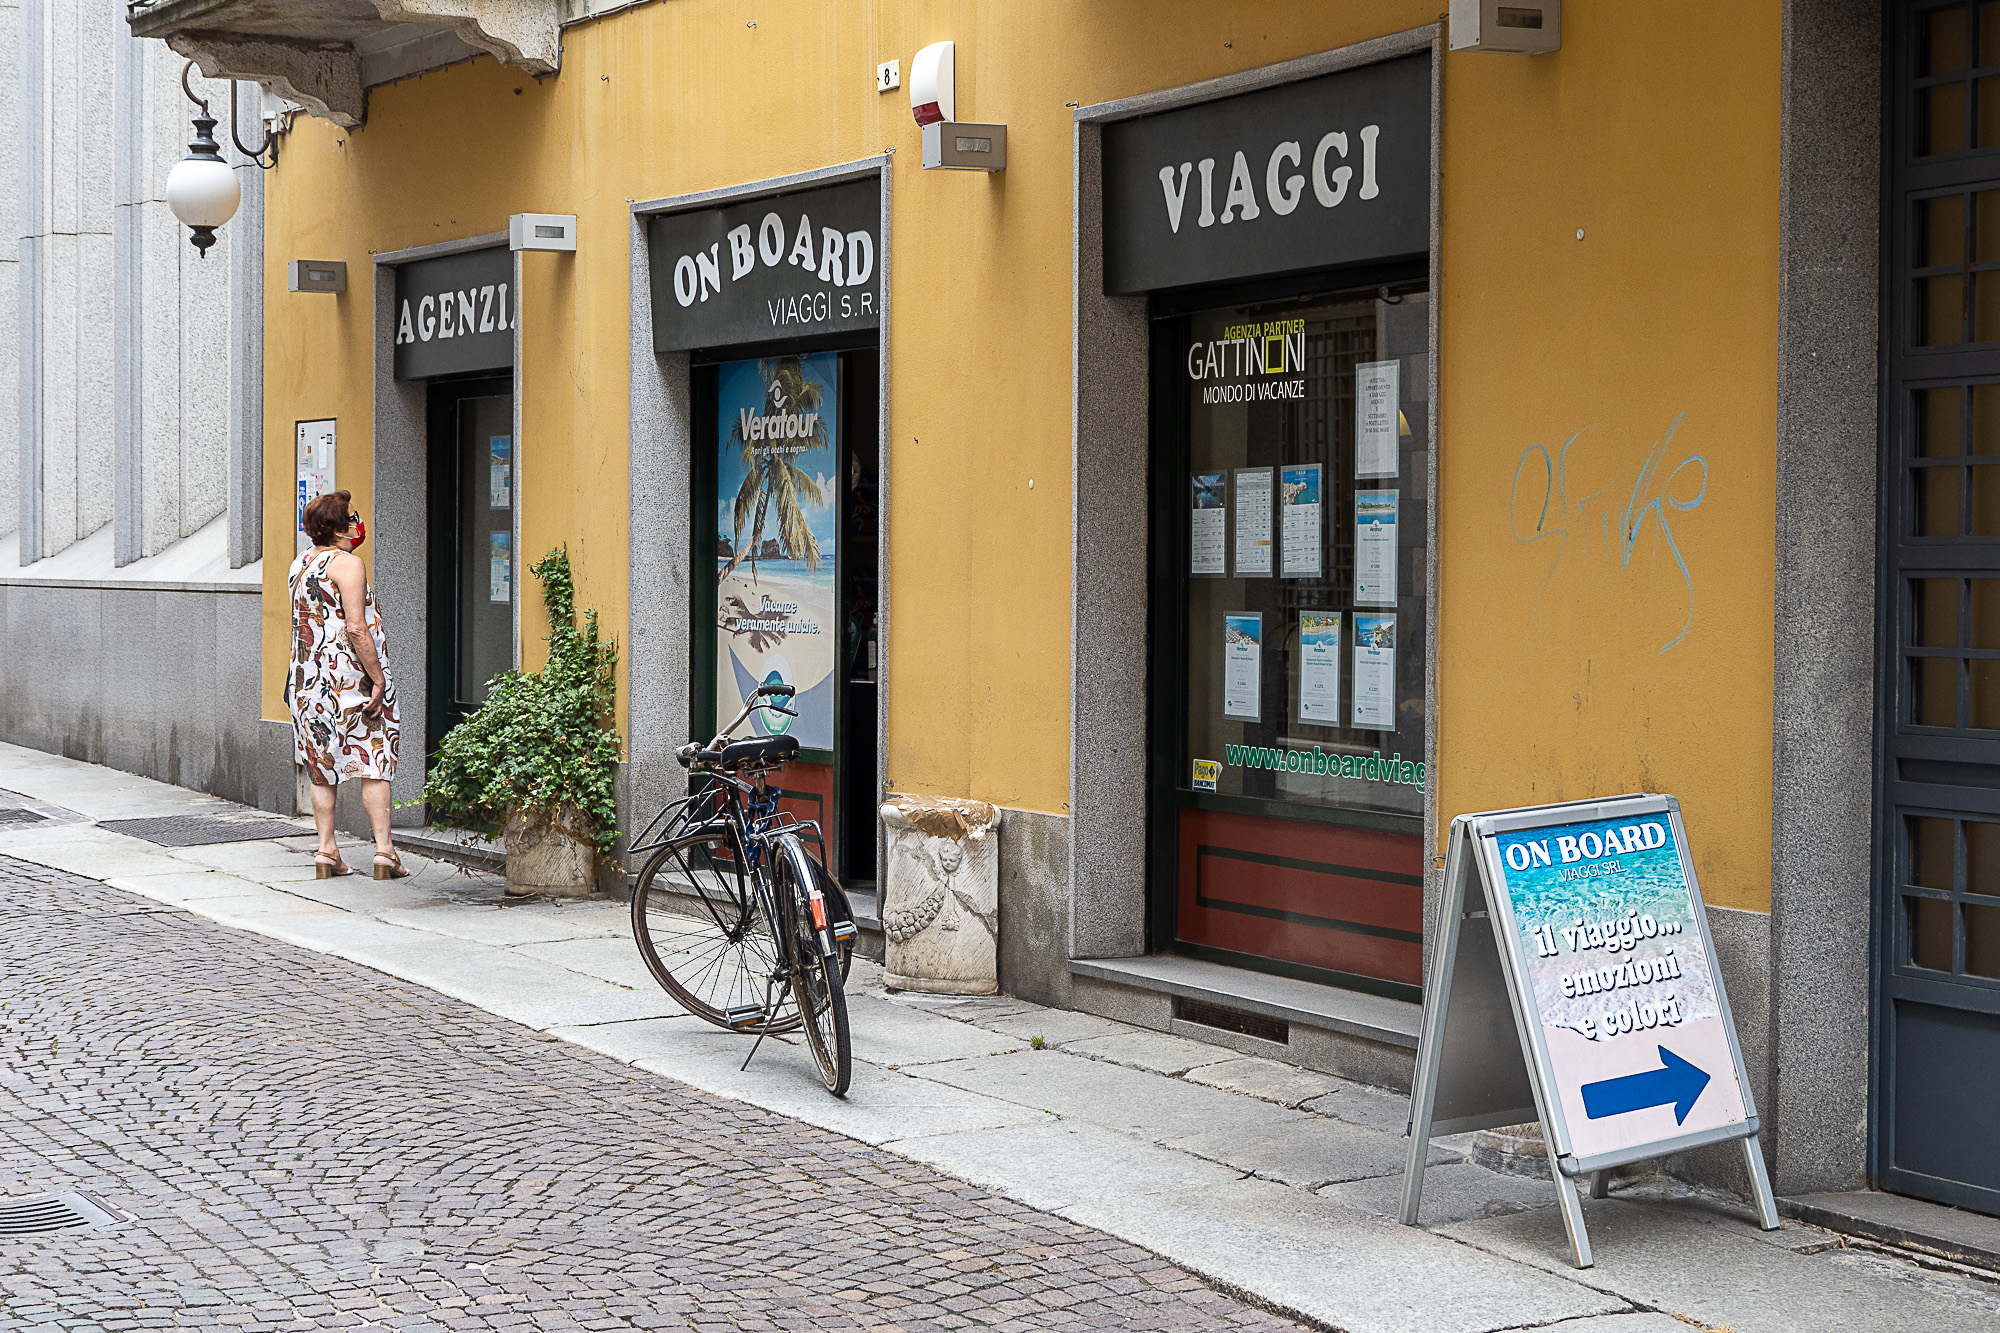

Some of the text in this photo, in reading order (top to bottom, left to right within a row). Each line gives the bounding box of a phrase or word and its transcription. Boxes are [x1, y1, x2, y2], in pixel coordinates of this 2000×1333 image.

[884, 67, 890, 86] 8
[1159, 124, 1380, 234] VIAGGI
[673, 212, 875, 308] ON BOARD
[396, 283, 515, 345] AGENZI
[767, 291, 832, 326] VIAGGI
[1223, 318, 1305, 341] AGENZIA PARTNER
[1188, 332, 1305, 380] GATTINONI
[1203, 379, 1305, 404] MONDO DI VACANZE
[740, 407, 818, 441] Veratour
[760, 596, 797, 614] Vacanze
[736, 617, 820, 634] veramente uniche.
[1194, 762, 1208, 779] Pago
[1194, 779, 1215, 788] BANCOMAT
[1506, 822, 1667, 872] ON BOARD
[1558, 860, 1626, 882] VIAGGI SRL
[1532, 908, 1682, 957] il viaggio...
[1559, 949, 1682, 999] emozioni
[1582, 991, 1682, 1040] e colori
